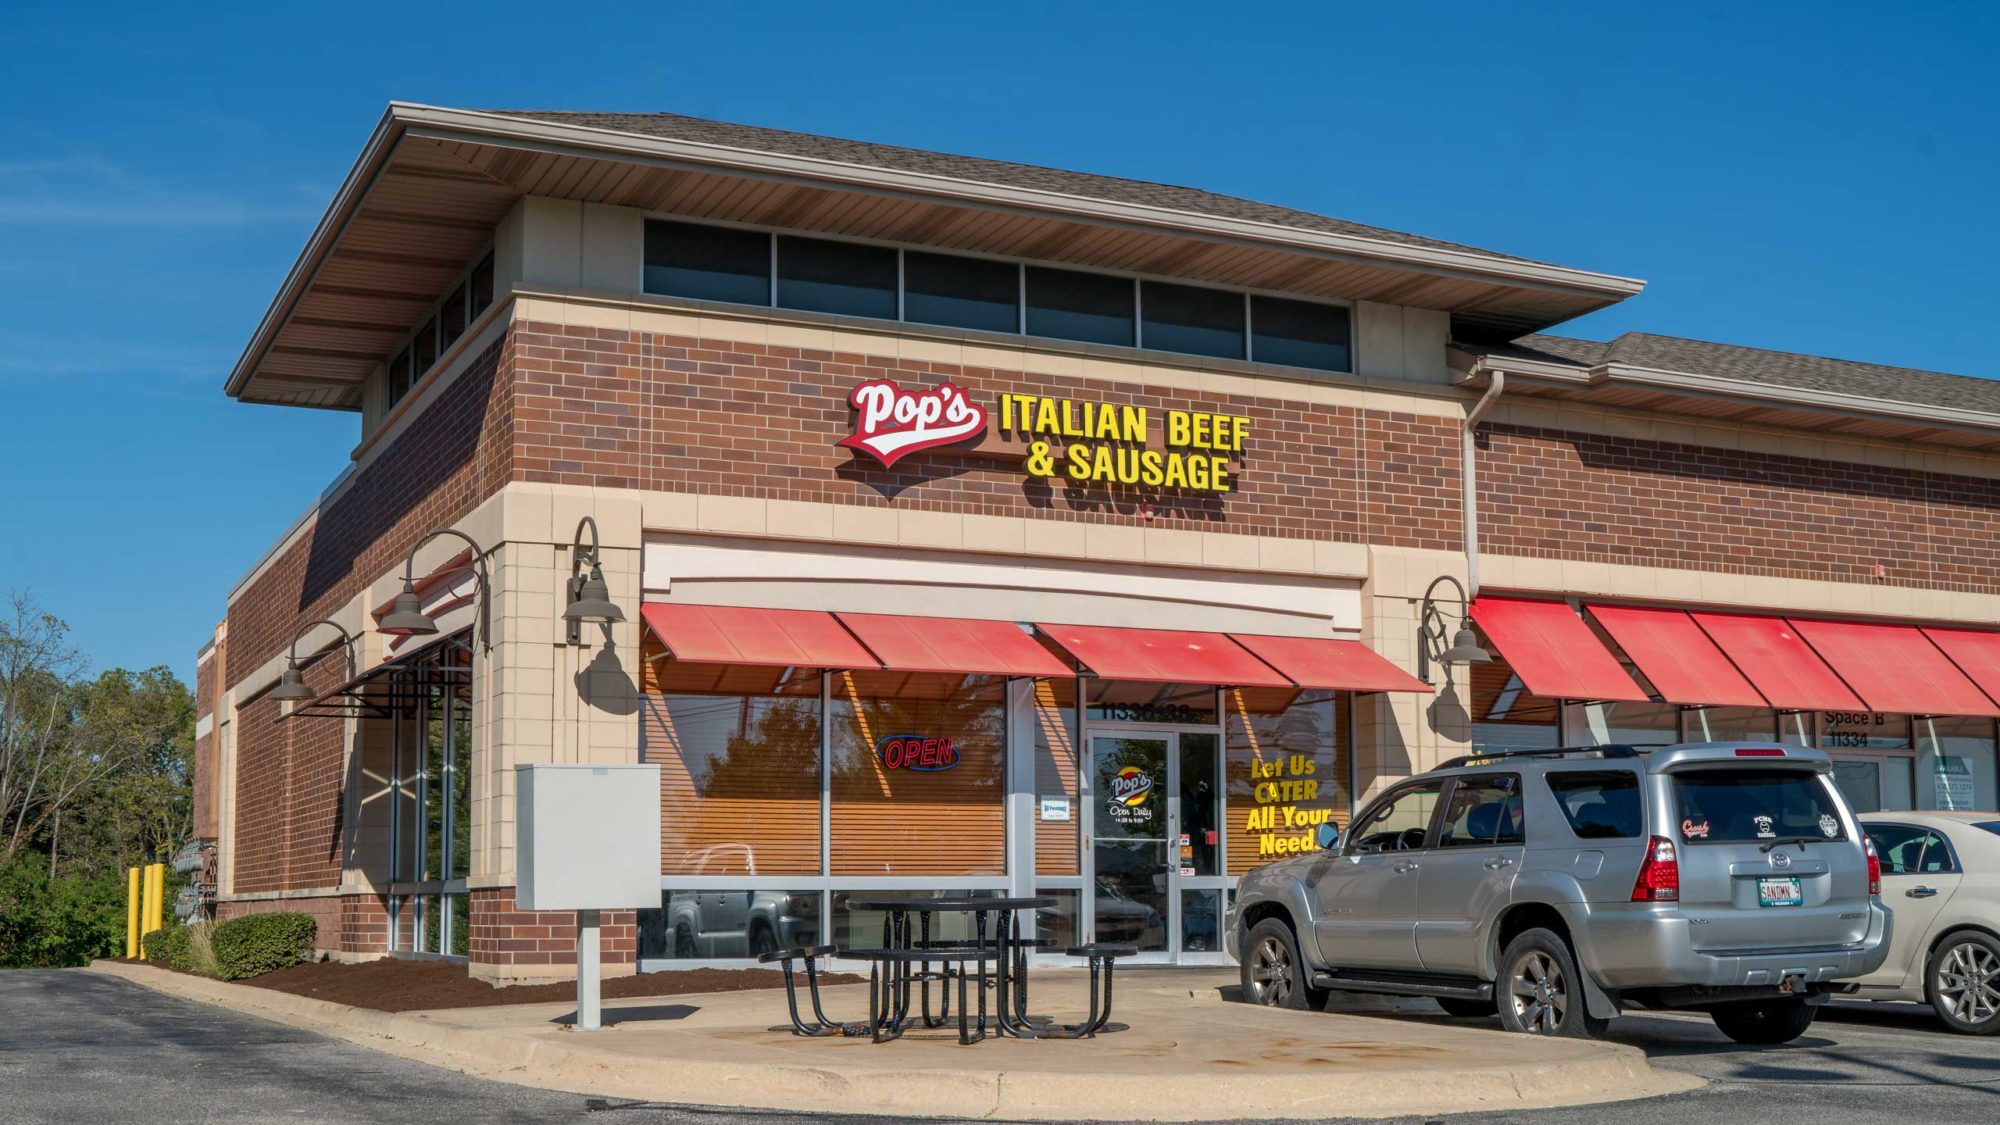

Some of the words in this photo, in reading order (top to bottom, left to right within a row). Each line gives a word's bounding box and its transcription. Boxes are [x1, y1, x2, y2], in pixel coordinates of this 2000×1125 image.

[856, 384, 974, 433] Pop's
[1001, 393, 1147, 443] ITALIAN
[1168, 410, 1251, 452] BEEF
[1026, 441, 1054, 476] &
[1068, 444, 1231, 491] SAUSAGE
[1826, 711, 1869, 726] Space
[1875, 712, 1885, 725] B
[1831, 732, 1869, 748] 11334
[884, 737, 954, 769] OPEN
[1252, 758, 1283, 778] Let
[1290, 755, 1316, 775] Us
[1112, 772, 1148, 797] Pop's
[1254, 779, 1318, 804] CATER
[1110, 806, 1130, 816] Open
[1133, 807, 1152, 820] Daily
[1246, 805, 1276, 830] All
[1282, 805, 1332, 827] Your
[1260, 828, 1322, 854] Need
[1762, 885, 1791, 900] SANDMN
